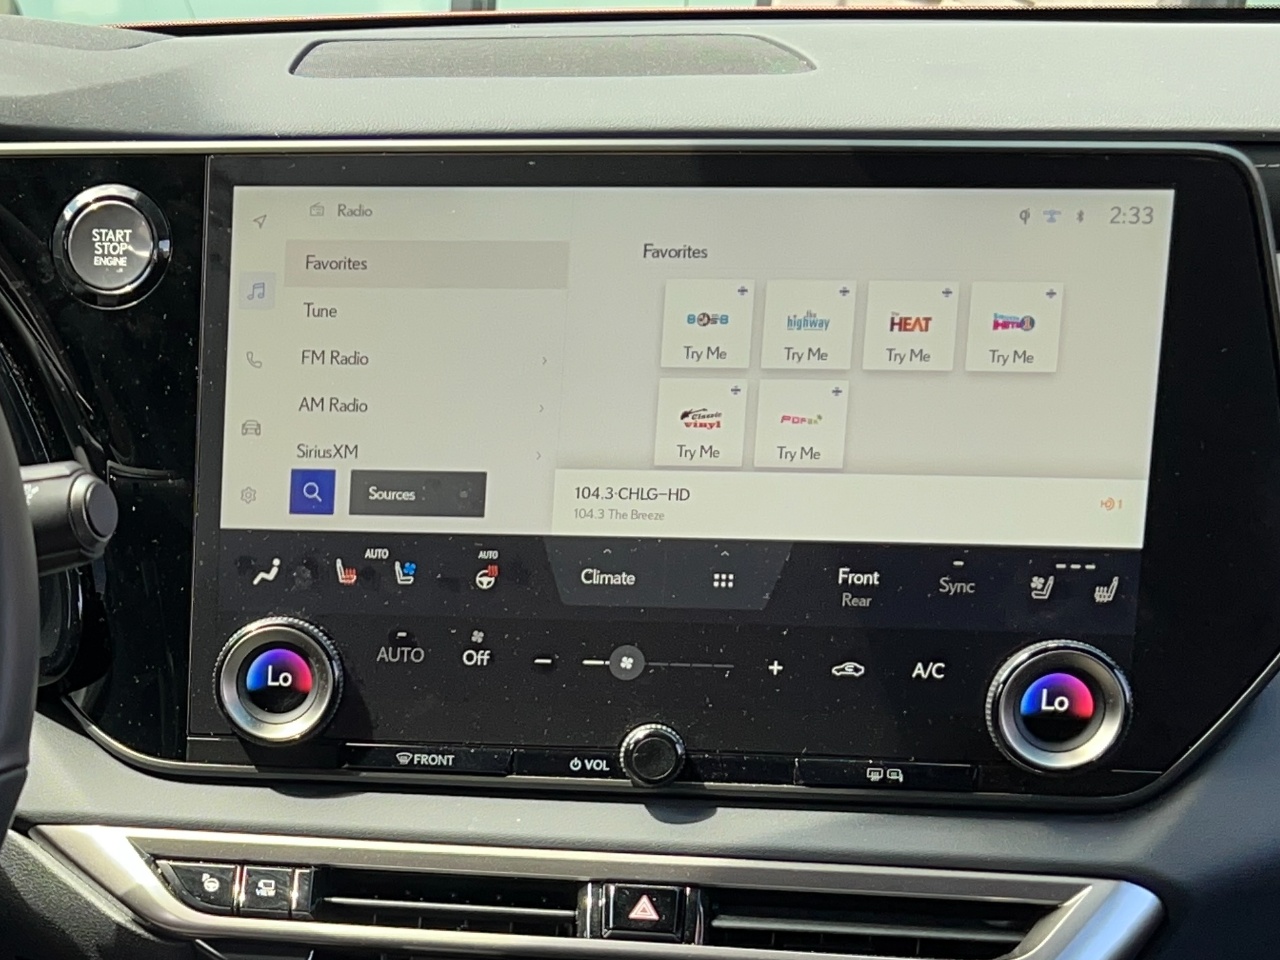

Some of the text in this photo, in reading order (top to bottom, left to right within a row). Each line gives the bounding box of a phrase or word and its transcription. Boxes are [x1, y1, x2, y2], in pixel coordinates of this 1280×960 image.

[338, 203, 373, 217] Radio
[1109, 206, 1154, 224] 2:33
[92, 229, 132, 242] START
[94, 242, 128, 255] STOP
[643, 243, 708, 259] Favorites
[94, 256, 127, 266] ENGINE
[305, 254, 368, 270] Favorites
[303, 302, 337, 318] Tune
[787, 314, 830, 331] highway
[890, 317, 932, 332] HEAT
[302, 350, 369, 365] FM Radio
[684, 346, 727, 362] Try Me
[784, 347, 828, 363] Try Me
[886, 348, 931, 364] Try Me
[989, 349, 1034, 366] Try Me
[298, 397, 368, 412] AM Radio
[297, 443, 358, 459] SiriusXM
[677, 445, 720, 461] Try Me
[777, 446, 820, 462] Try Me
[369, 486, 416, 501] Sources
[574, 508, 665, 521] 104.3 The Breeze
[364, 549, 389, 559] AUTO
[478, 551, 499, 560] AUTO
[580, 569, 637, 586] Climate
[838, 568, 880, 586] Front
[939, 578, 975, 595] Sync
[841, 593, 872, 608] Rear
[376, 647, 425, 663] AUTO
[462, 650, 490, 666] Off
[267, 665, 292, 687] Lo
[911, 662, 946, 679] A/C
[1041, 688, 1069, 712] Lo
[413, 754, 455, 766] FRONT
[584, 759, 610, 771] VOL
